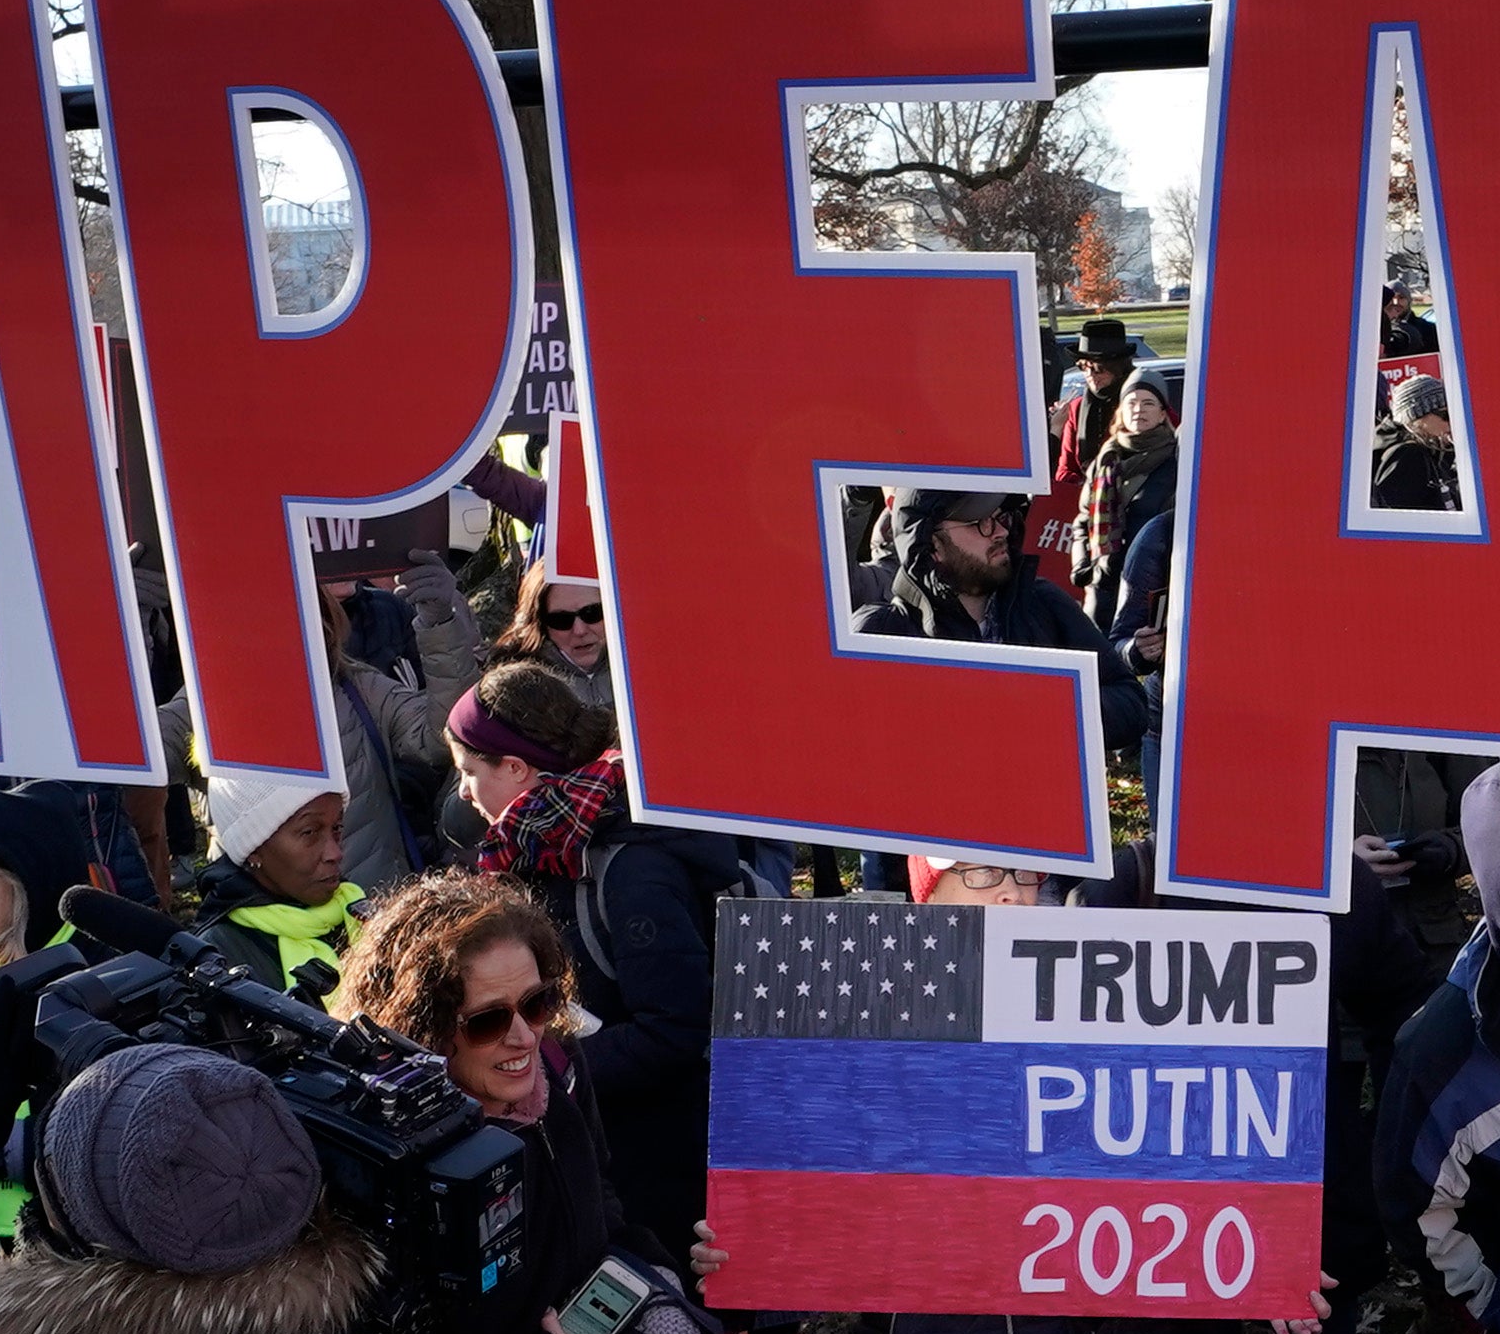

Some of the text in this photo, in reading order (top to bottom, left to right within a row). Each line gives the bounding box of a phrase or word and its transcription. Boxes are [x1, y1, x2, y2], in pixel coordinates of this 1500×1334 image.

[1010, 939, 1318, 1027] TRUMP
[1025, 1064, 1294, 1158] PUTIN
[1018, 1203, 1257, 1301] 2020
